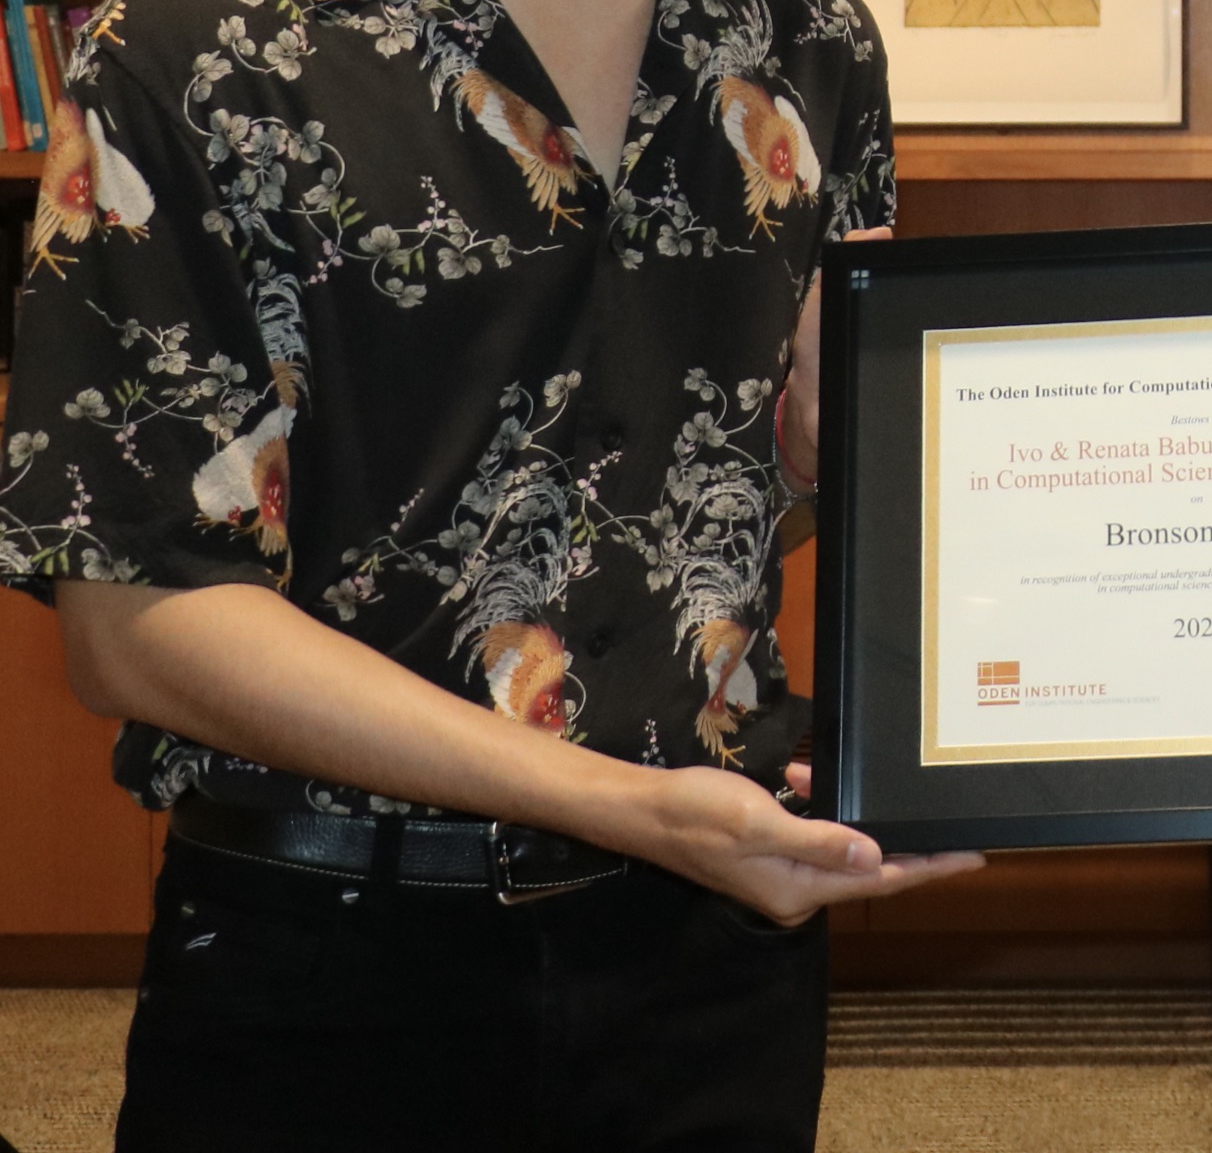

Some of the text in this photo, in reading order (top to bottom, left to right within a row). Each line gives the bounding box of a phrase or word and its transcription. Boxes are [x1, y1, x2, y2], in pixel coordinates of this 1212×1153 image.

[957, 388, 985, 402] The
[990, 386, 1029, 400] Oden
[1035, 383, 1098, 398] Institute
[1103, 381, 1124, 395] for
[1171, 414, 1209, 426] Bestows
[1009, 443, 1043, 463] Ivo
[1050, 441, 1069, 461] &
[1078, 440, 1150, 460] Renata
[970, 471, 989, 491] in
[997, 463, 1152, 492] Computational
[1190, 496, 1203, 504] on
[1020, 575, 1030, 585] in
[1032, 574, 1087, 586] recognition
[1089, 571, 1100, 584] of
[1101, 570, 1158, 584] exceptional
[1097, 583, 1107, 594] in
[1108, 581, 1179, 594] computational
[977, 684, 1107, 700] ODEN INSTITUTE
